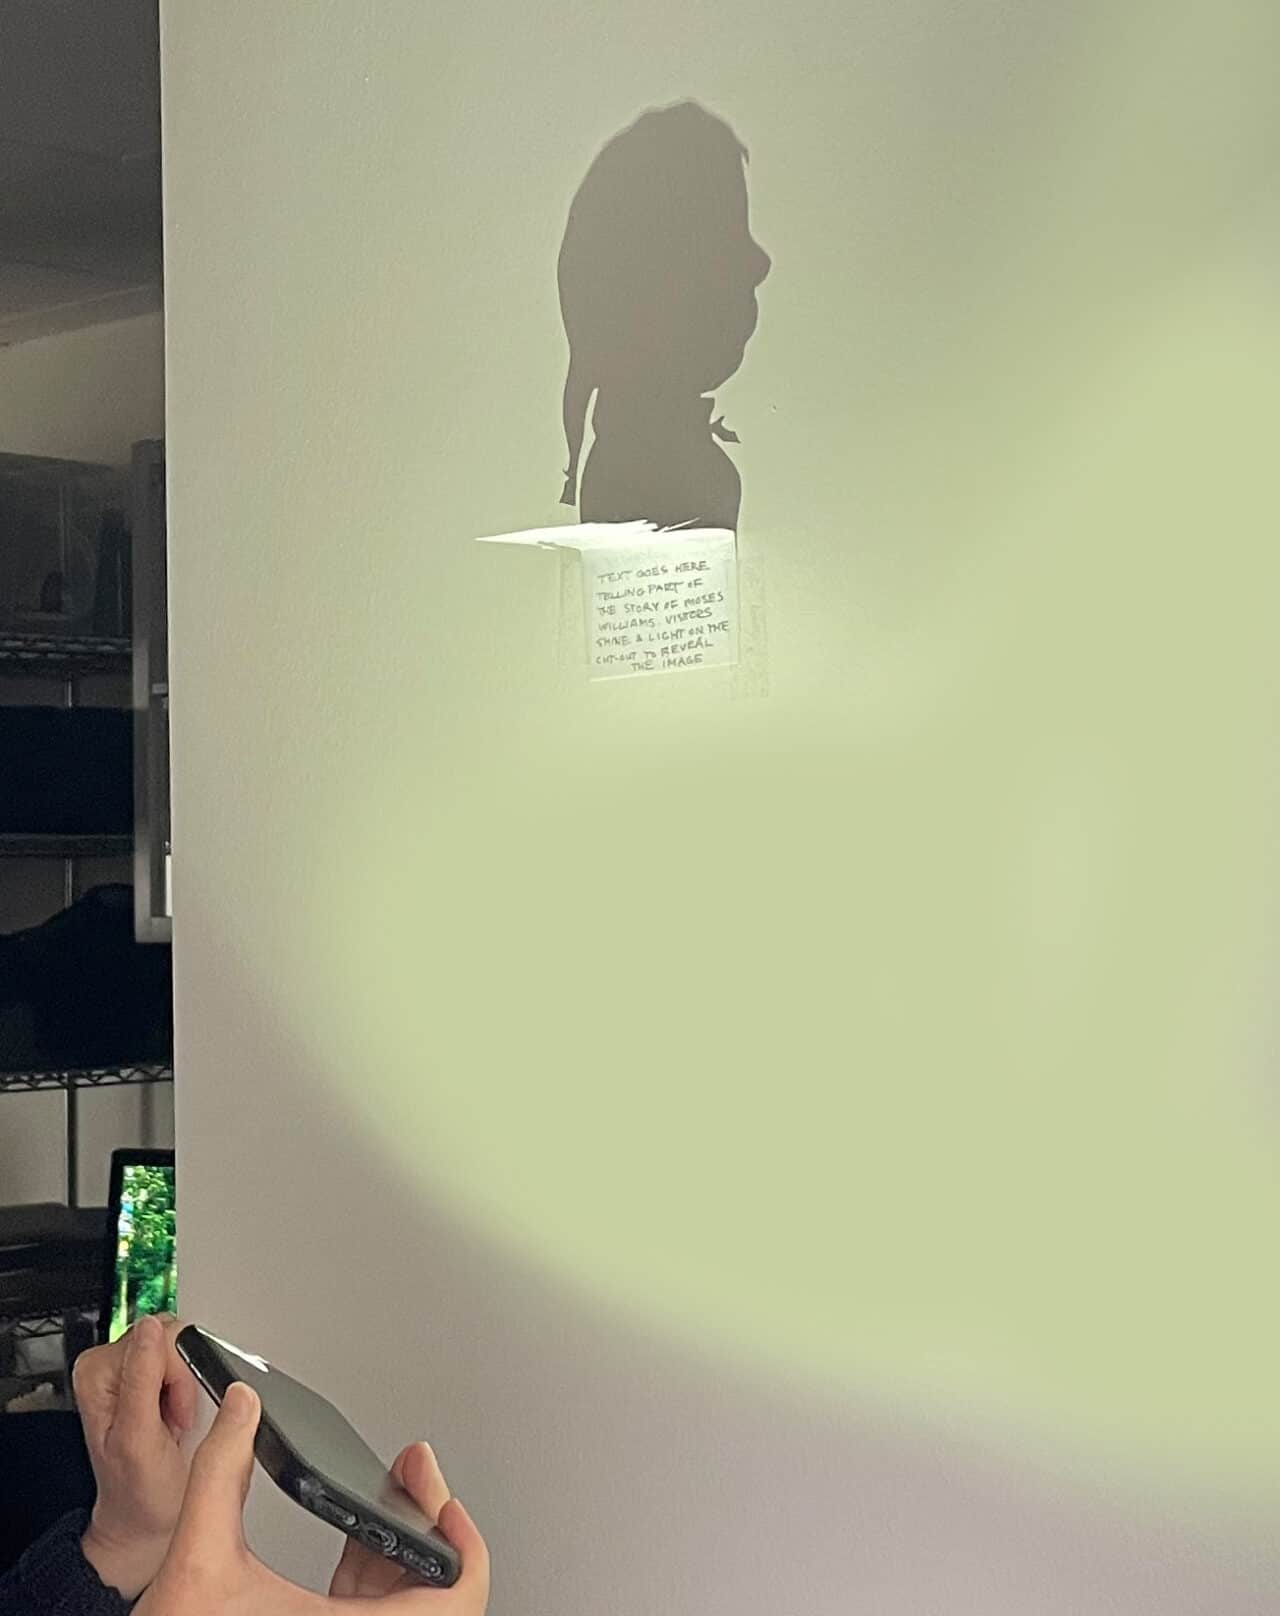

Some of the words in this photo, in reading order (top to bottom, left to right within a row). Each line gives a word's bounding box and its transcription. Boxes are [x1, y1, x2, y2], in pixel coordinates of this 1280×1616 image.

[597, 570, 632, 584] TEXT
[636, 566, 669, 577] GOES
[675, 561, 710, 572] HERE
[596, 588, 645, 600] TELLING
[647, 582, 684, 594] PART
[687, 578, 703, 588] OF
[624, 602, 659, 613] STORY
[664, 600, 678, 610] OF
[684, 592, 724, 608] MOSES
[596, 635, 631, 647] SHINE
[649, 629, 685, 641] LIGHT
[688, 625, 704, 636] ON
[707, 621, 729, 633] THE
[660, 637, 714, 657] REVEAL
[632, 659, 654, 671] THE
[663, 653, 703, 668] IMAGE
